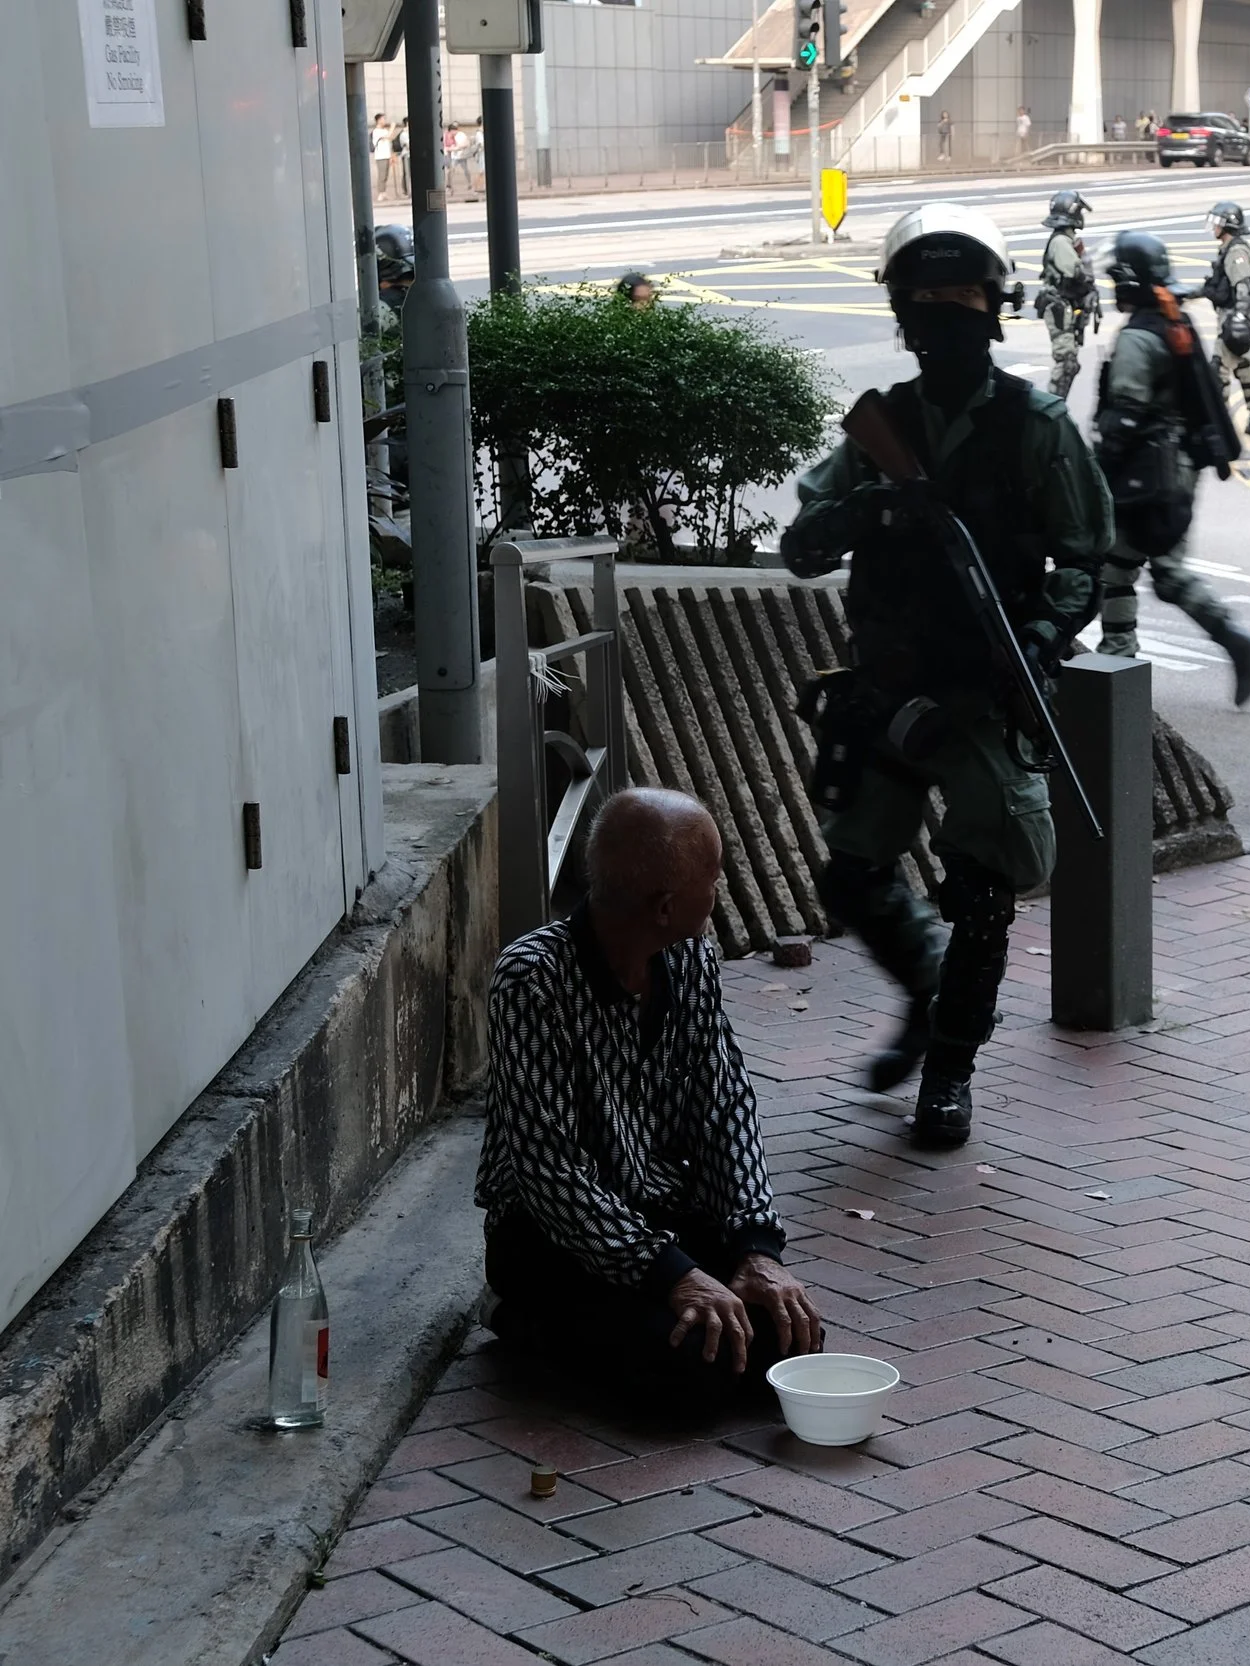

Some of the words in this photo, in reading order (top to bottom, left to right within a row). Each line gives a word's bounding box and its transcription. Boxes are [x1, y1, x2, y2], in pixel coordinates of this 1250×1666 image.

[105, 44, 118, 63] Gas
[118, 45, 140, 66] Facility
[106, 71, 117, 91] No
[118, 71, 144, 93] Smoking
[921, 248, 961, 260] Police
